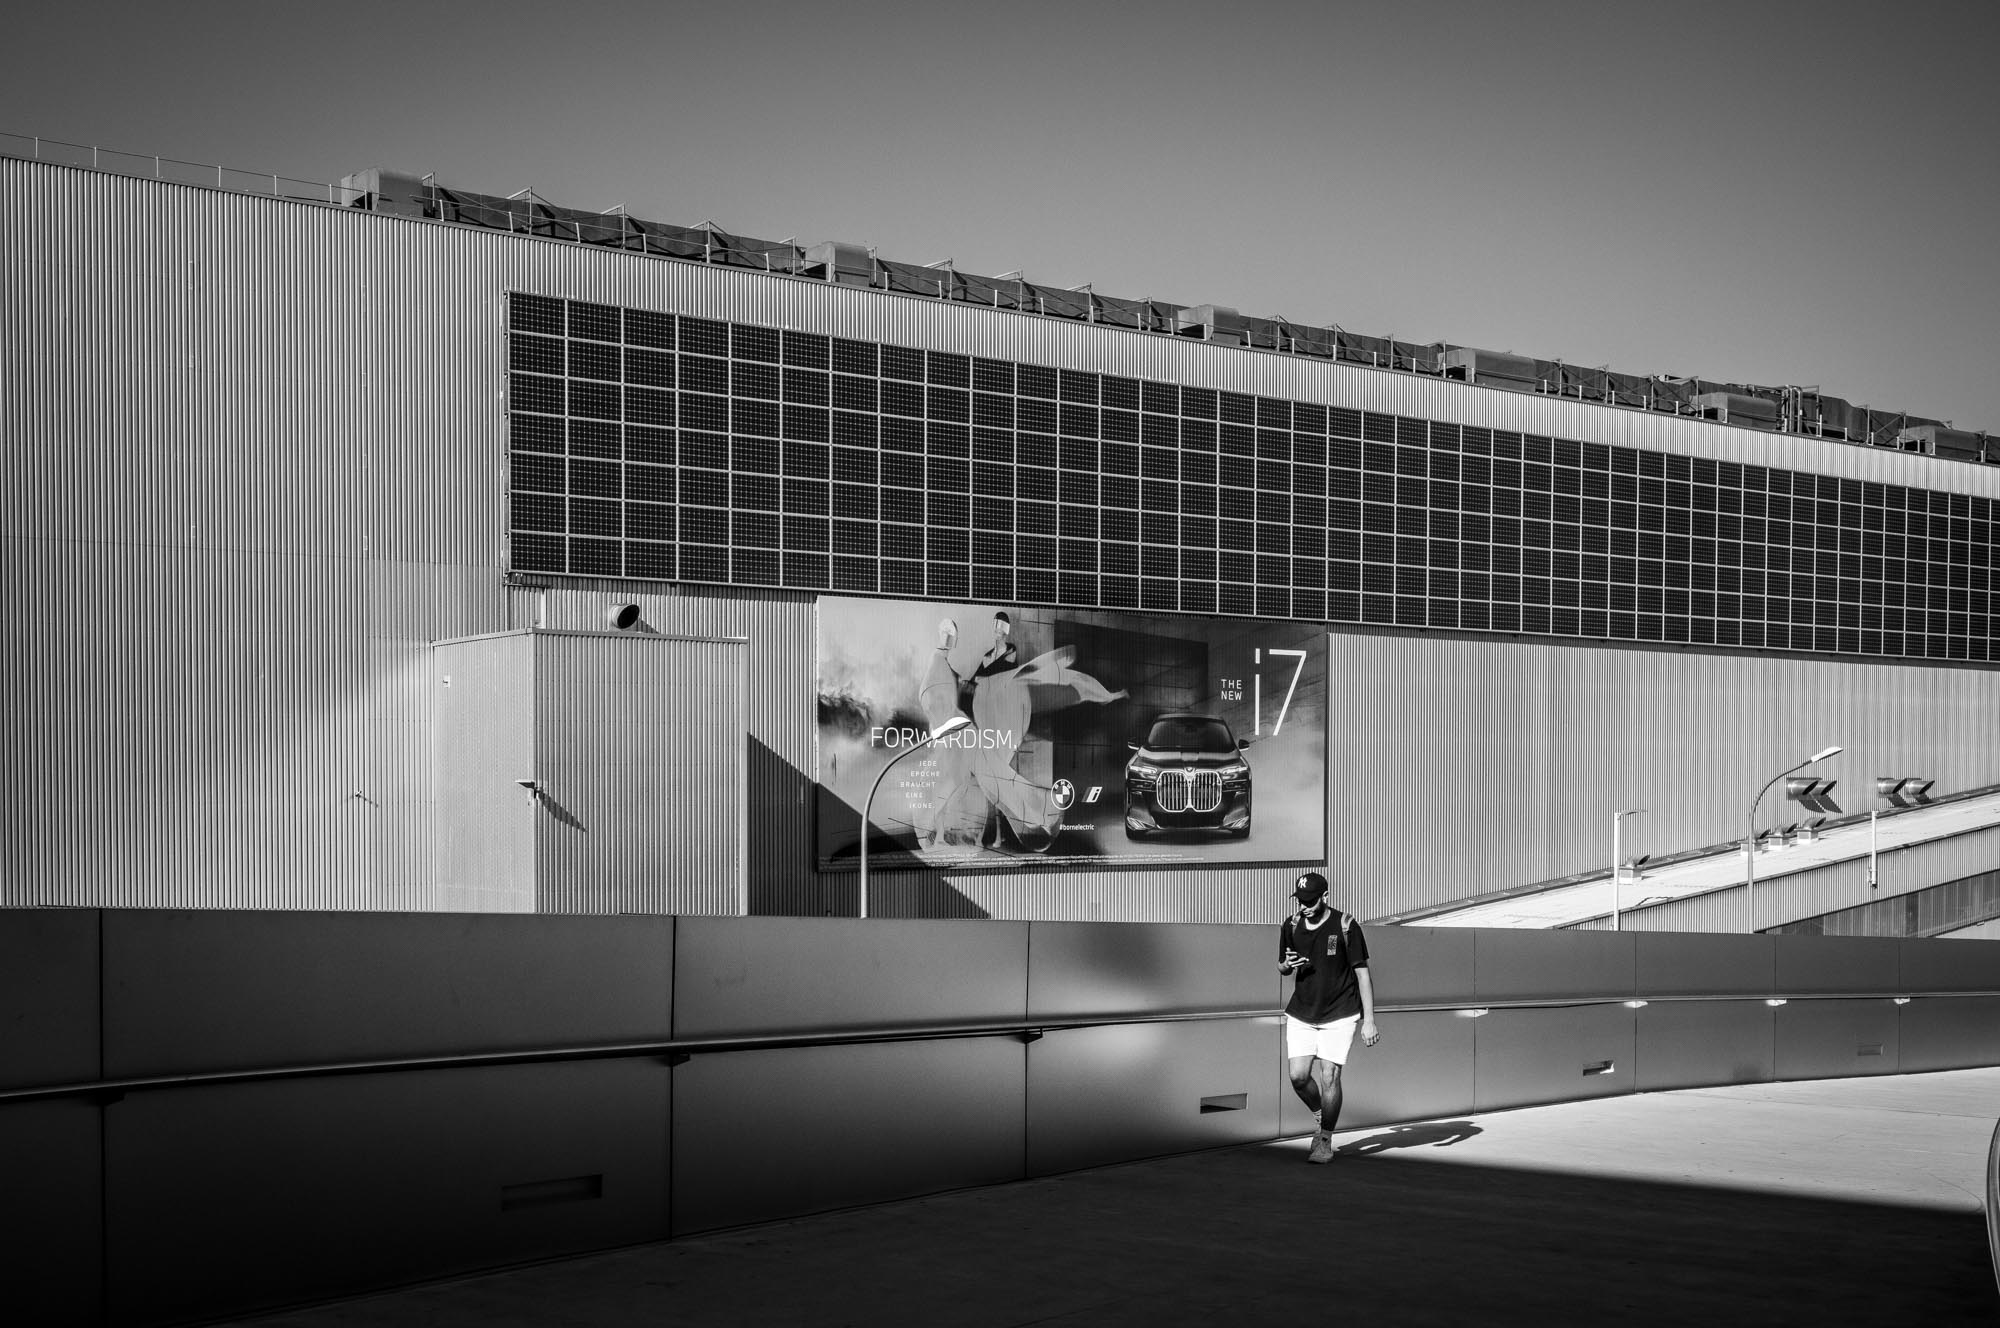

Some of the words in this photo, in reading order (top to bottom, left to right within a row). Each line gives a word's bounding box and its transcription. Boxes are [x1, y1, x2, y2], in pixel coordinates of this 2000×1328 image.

[1221, 679, 1242, 690] THE
[1221, 690, 1242, 701] NEW
[1255, 648, 1307, 736] i7
